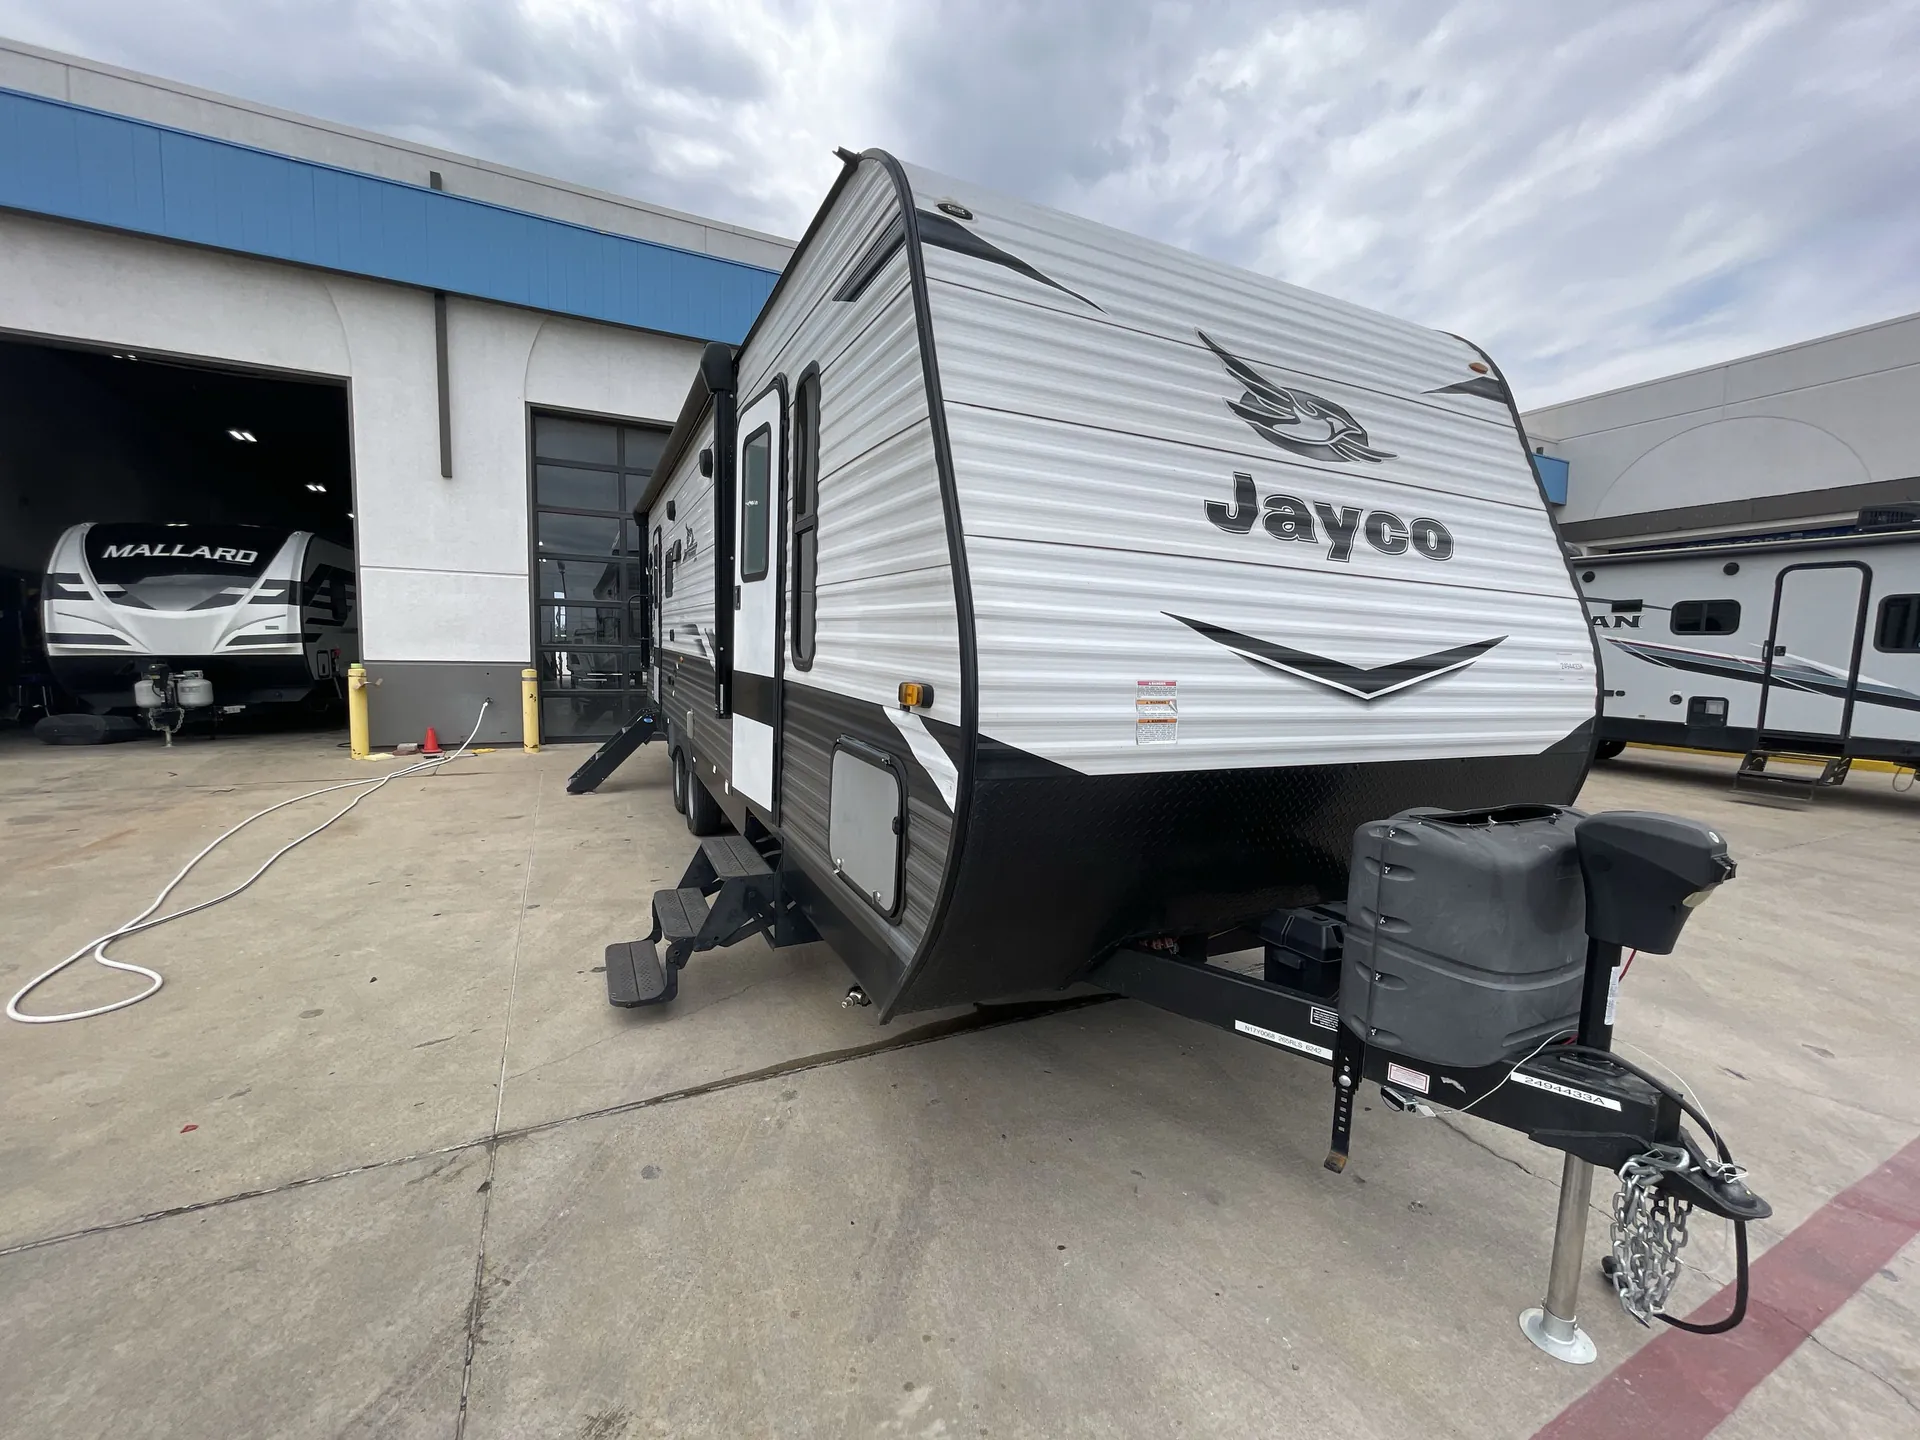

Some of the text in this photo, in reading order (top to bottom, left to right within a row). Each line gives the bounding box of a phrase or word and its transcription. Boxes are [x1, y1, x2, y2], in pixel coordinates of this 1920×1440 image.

[1203, 470, 1455, 563] Jayco
[102, 543, 259, 564] MALLARD
[1305, 1044, 1322, 1055] 6242
[1524, 1077, 1605, 1106] 2494433A
